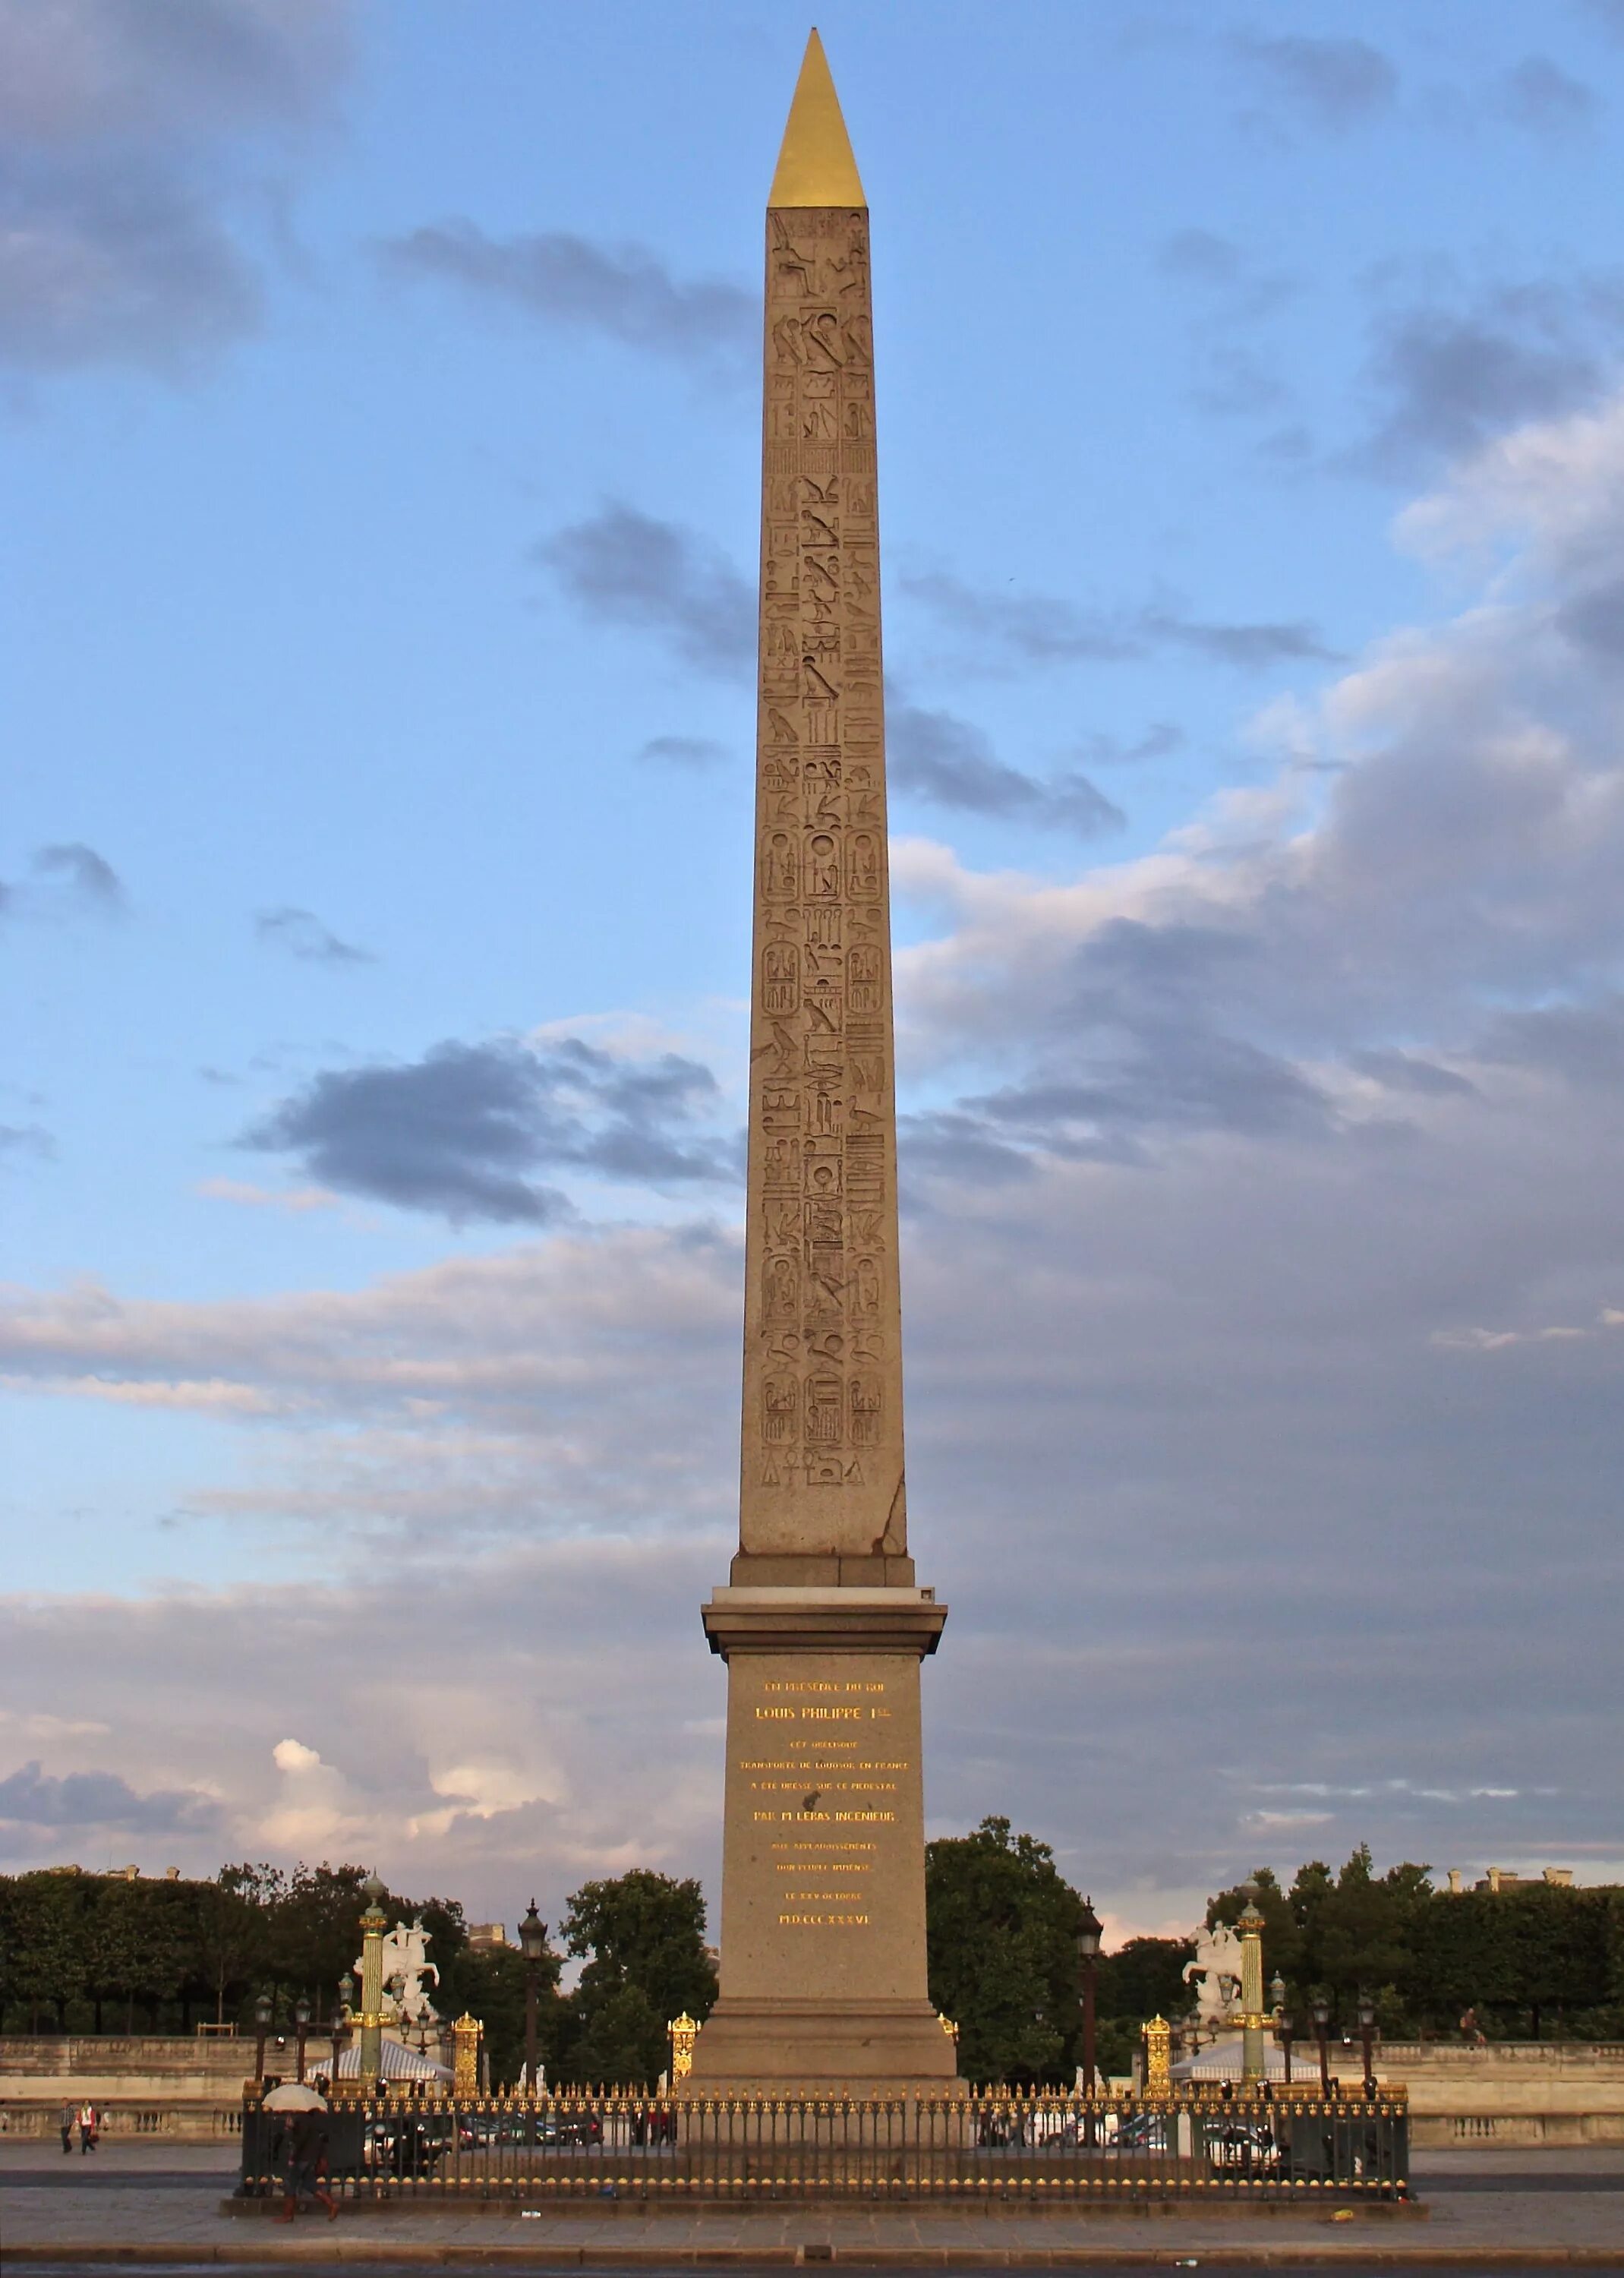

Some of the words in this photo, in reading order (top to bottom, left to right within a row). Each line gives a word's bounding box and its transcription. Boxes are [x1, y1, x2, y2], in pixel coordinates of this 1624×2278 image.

[765, 1682, 780, 1692] EN
[846, 1682, 862, 1692] DU
[866, 1682, 884, 1692] ROI
[755, 1707, 796, 1719] LOUIS
[801, 1707, 862, 1719] PHILIPPE
[799, 1761, 810, 1769] DE
[859, 1761, 872, 1769] EN
[875, 1761, 909, 1769] FRANCE
[836, 1781, 847, 1790] CE
[753, 1811, 776, 1821] PAR
[796, 1811, 831, 1821] LEBAS
